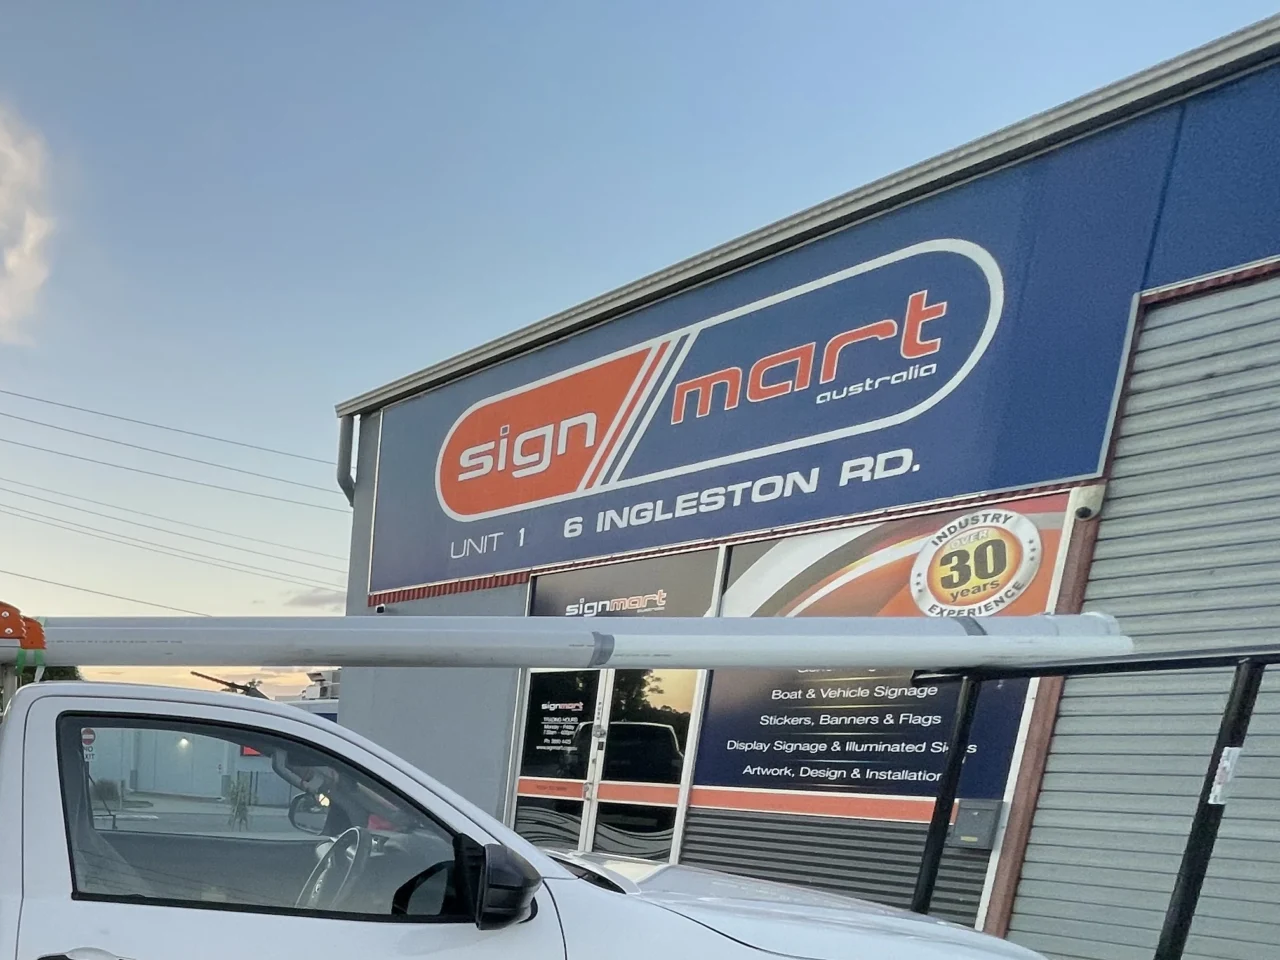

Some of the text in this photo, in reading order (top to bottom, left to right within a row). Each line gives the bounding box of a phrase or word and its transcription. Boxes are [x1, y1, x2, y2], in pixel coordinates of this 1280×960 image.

[457, 290, 948, 483] sign mart
[816, 363, 937, 404] australia
[451, 448, 920, 560] UNIT 1 6 INGLESTON RD.
[931, 513, 1013, 547] INDUSTRY
[949, 529, 990, 551] OVER
[939, 539, 1007, 590] 30
[565, 589, 667, 617] signmart
[927, 580, 1025, 617] EXPERIENCE
[949, 579, 1001, 603] years
[771, 685, 938, 700] Boat & Vehicle Signage
[759, 713, 942, 728] Stickers, Banners & Flags
[726, 739, 978, 758] Display Signage & Illuminated Sis
[742, 764, 795, 778] Artwork,
[799, 767, 847, 781] Design
[850, 768, 861, 779] &
